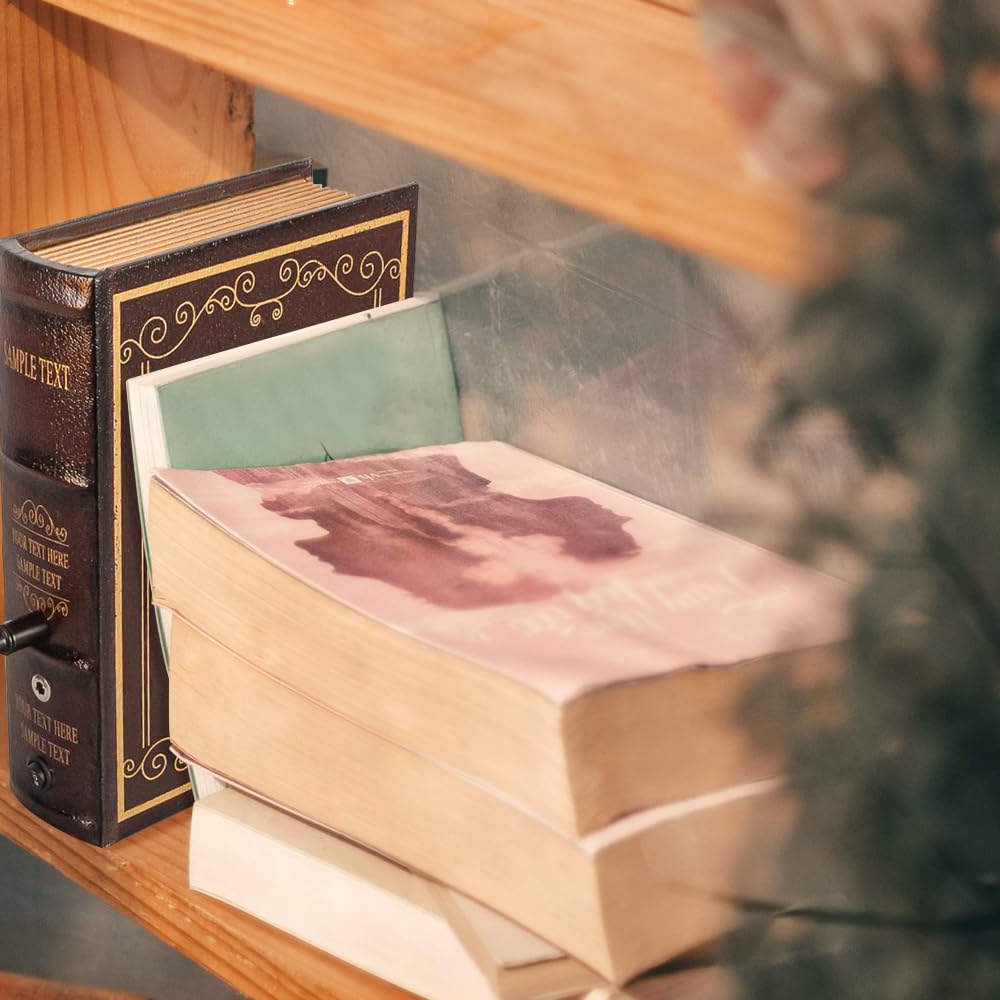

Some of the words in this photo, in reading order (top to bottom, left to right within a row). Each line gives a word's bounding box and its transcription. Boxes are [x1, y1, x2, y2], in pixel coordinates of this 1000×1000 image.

[3, 340, 38, 381] SAMPLE
[38, 357, 71, 391] TEXT
[16, 553, 41, 582] SAMPLE
[41, 568, 63, 591] TEXT
[27, 537, 47, 561] TEXT
[47, 546, 71, 570] HERE
[32, 706, 53, 733] TEXT
[53, 719, 79, 745] HERE
[47, 740, 71, 766] TEXT
